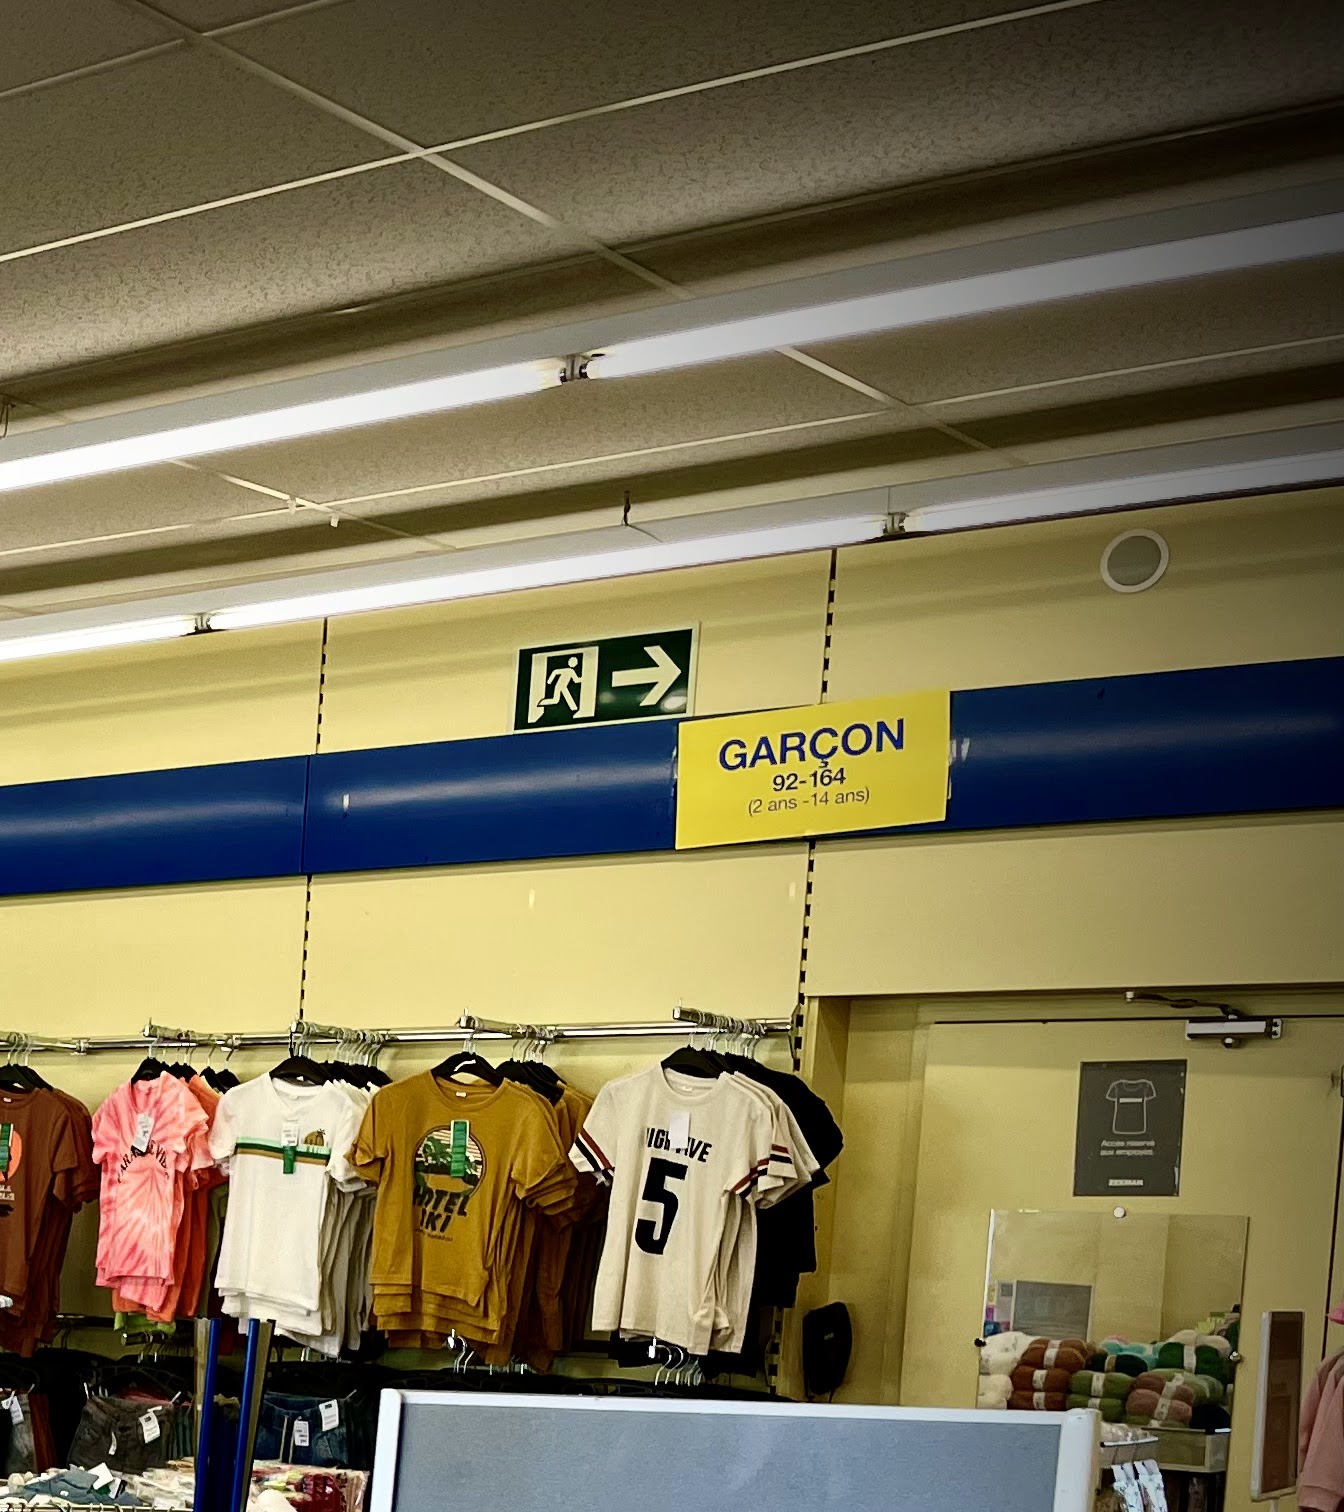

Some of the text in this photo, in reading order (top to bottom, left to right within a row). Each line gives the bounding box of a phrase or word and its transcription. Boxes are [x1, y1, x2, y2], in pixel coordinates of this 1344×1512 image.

[719, 718, 904, 769] GARÇON
[773, 768, 846, 791] 92-164
[748, 799, 763, 817] (2
[768, 796, 798, 812] ans
[835, 787, 871, 805] ans)
[635, 1157, 688, 1255] 5
